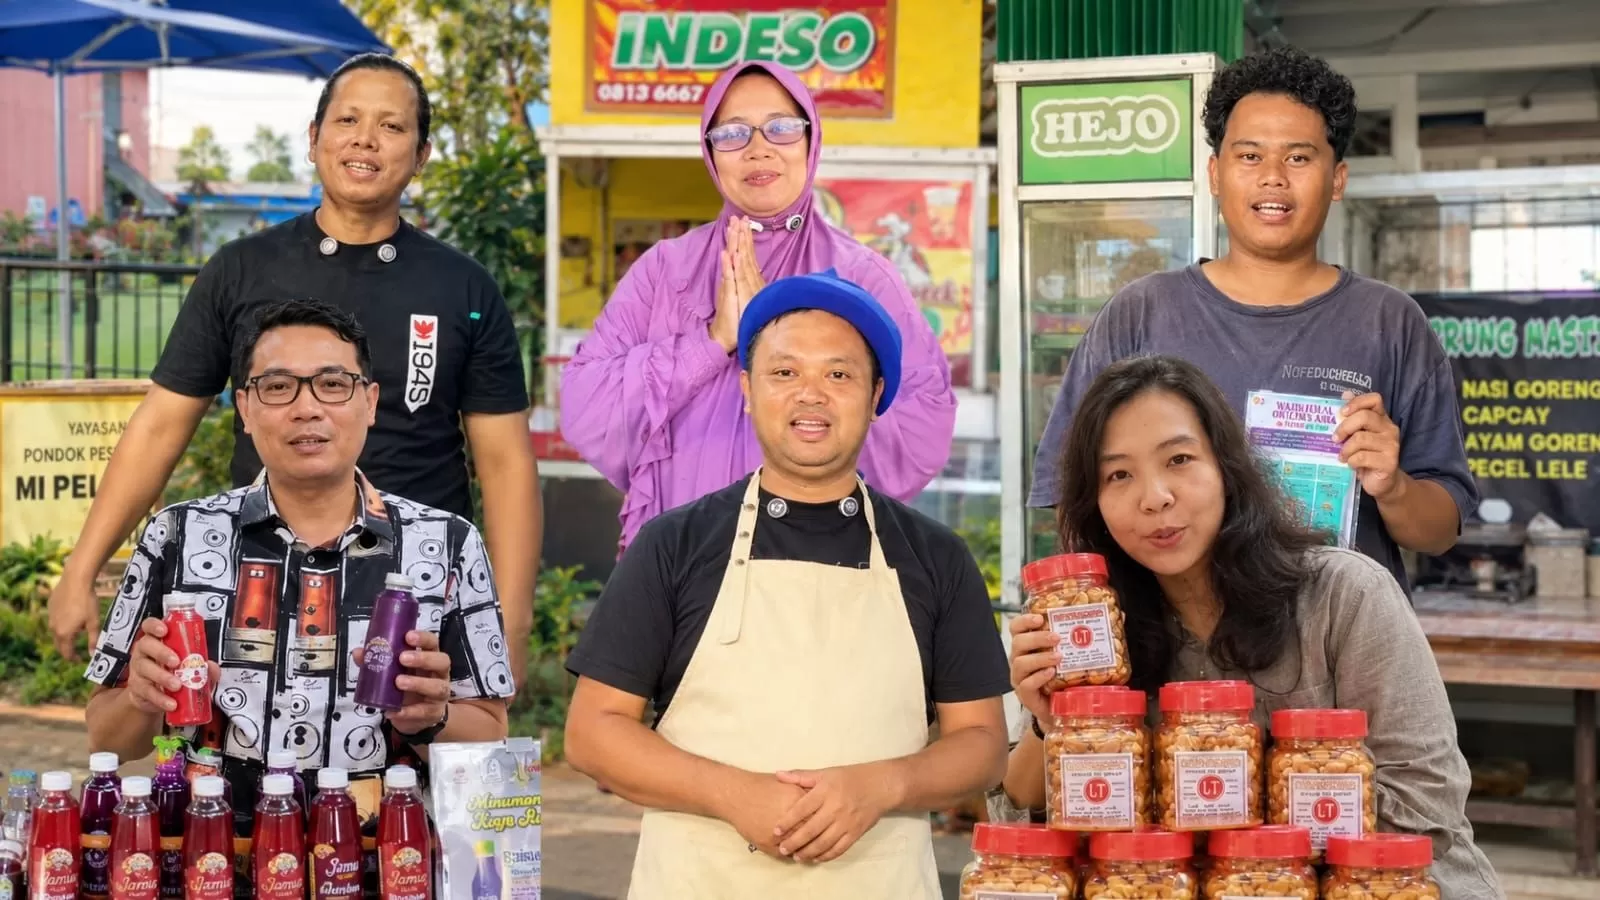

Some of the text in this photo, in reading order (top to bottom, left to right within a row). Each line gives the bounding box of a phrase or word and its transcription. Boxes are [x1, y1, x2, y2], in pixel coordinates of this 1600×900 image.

[611, 11, 876, 72] INDESO
[597, 83, 705, 103] 0813 6667
[1043, 107, 1168, 144] HEJO
[1523, 315, 1600, 359] MAST
[1462, 380, 1509, 399] NASI
[1462, 406, 1551, 425] CAPCAY
[1464, 433, 1524, 451] AYAM
[24, 447, 85, 463] PONDOK
[1468, 458, 1588, 479] PECEL LELE
[16, 475, 45, 500] MI
